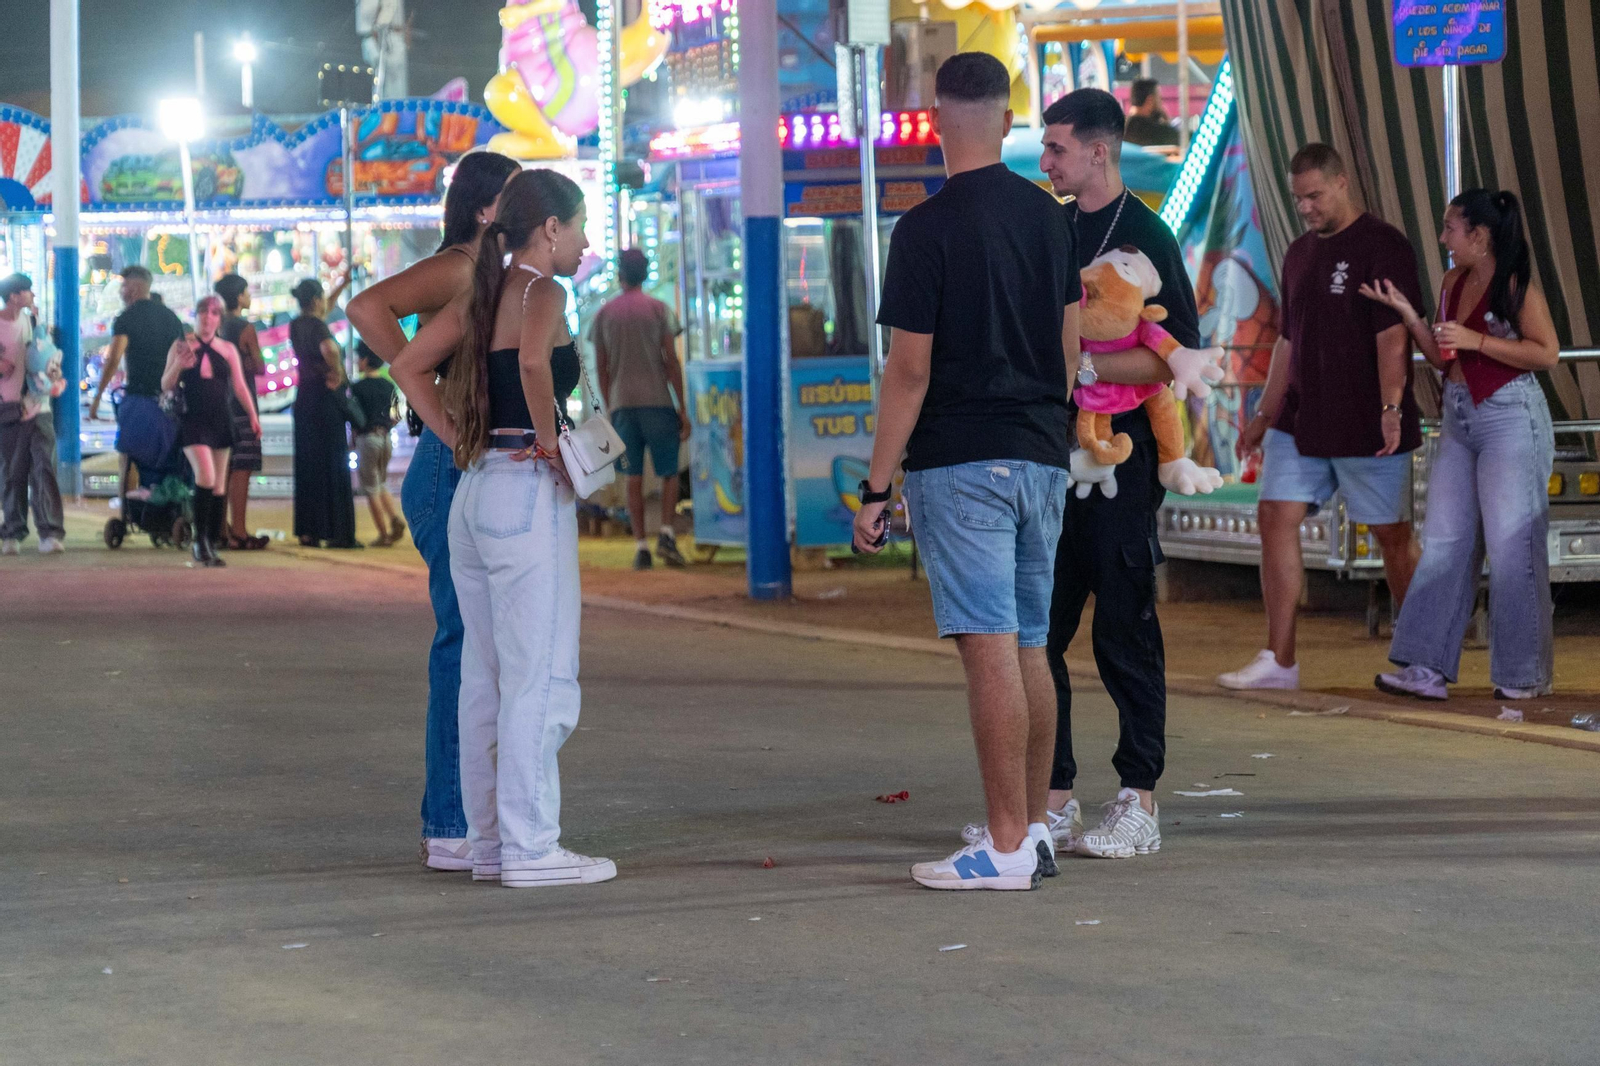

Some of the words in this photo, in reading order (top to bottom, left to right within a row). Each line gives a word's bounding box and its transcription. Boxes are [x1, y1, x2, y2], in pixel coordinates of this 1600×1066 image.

[1399, 5, 1437, 18] PUEDEN
[1407, 27, 1414, 36] A
[1418, 26, 1438, 36] LOS
[1478, 23, 1492, 33] DE
[1457, 44, 1488, 60] PAGAR
[813, 415, 856, 435] TUS
